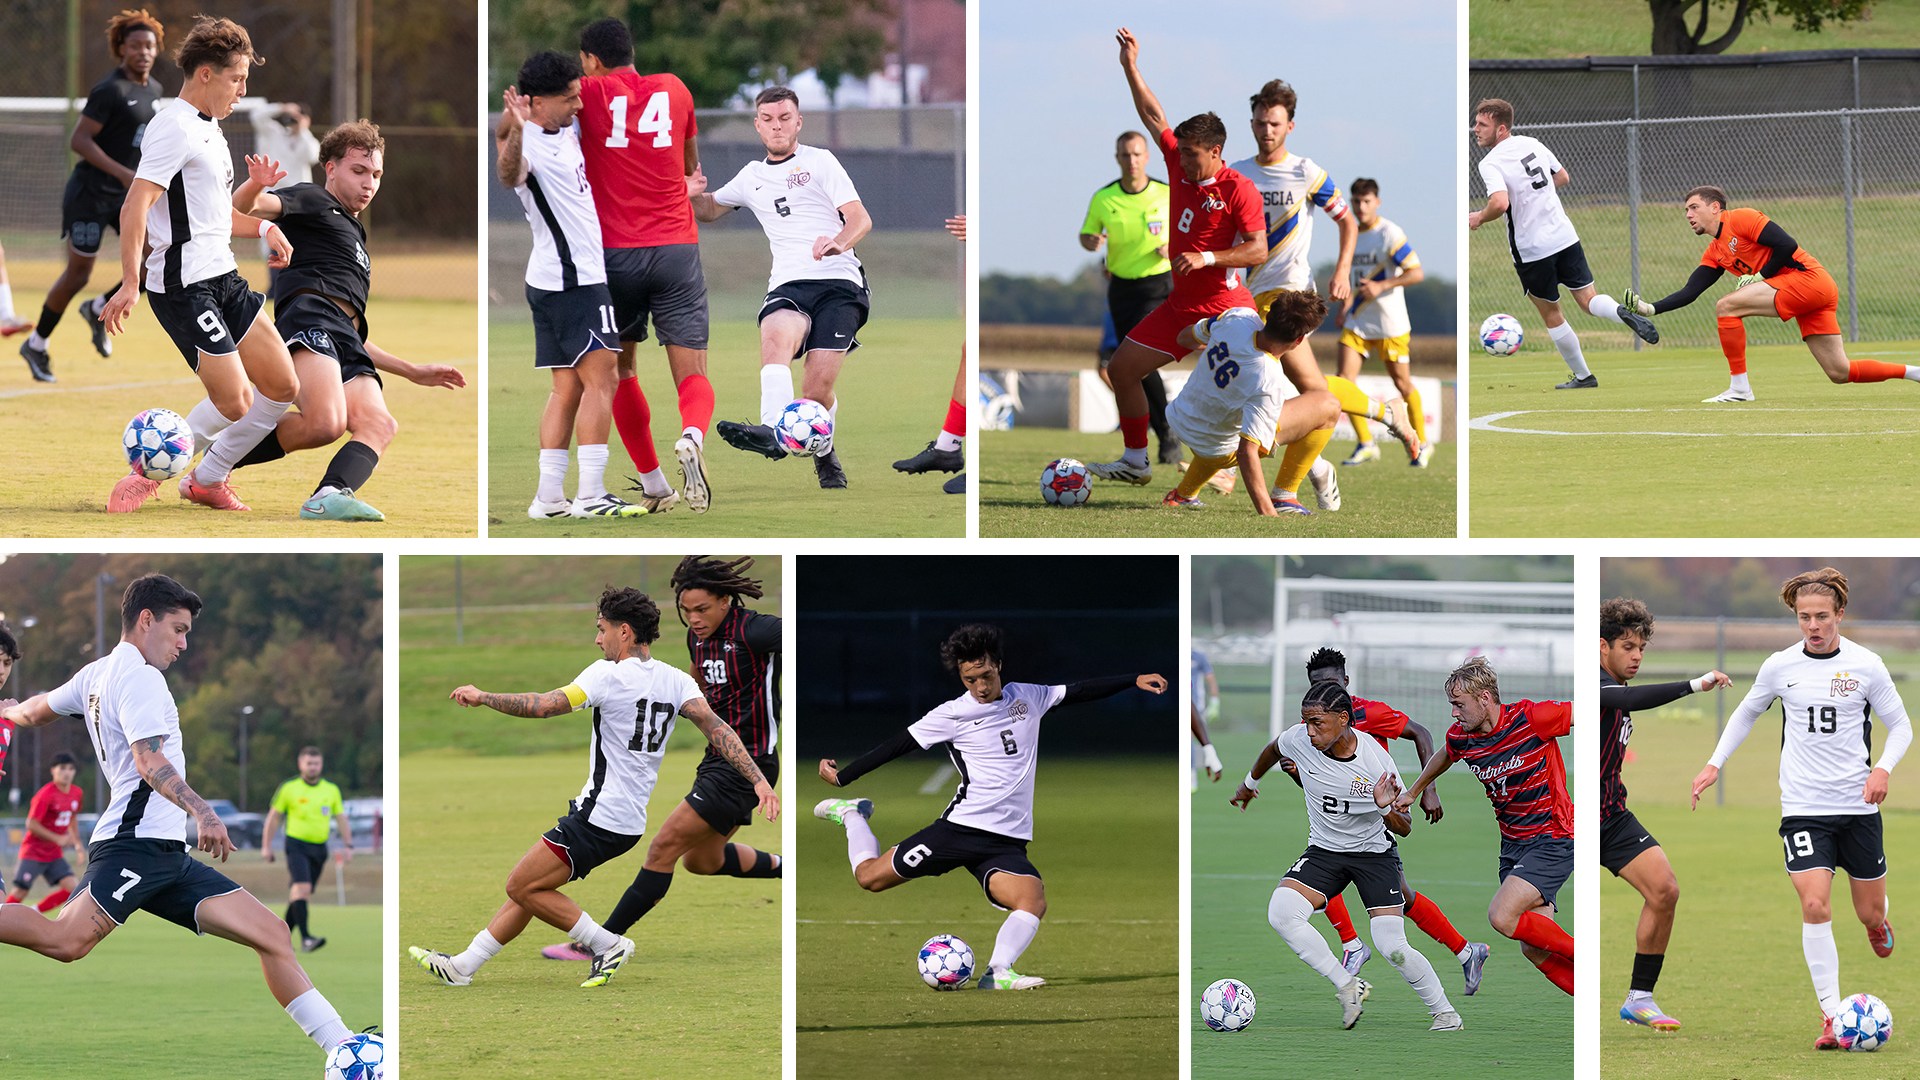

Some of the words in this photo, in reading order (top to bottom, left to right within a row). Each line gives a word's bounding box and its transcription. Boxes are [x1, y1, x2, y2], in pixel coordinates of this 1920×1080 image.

[605, 91, 673, 148] 14
[786, 171, 811, 190] RIO
[1520, 152, 1549, 190] 5
[1260, 190, 1294, 206] SCIA
[1177, 207, 1195, 234] 8
[197, 310, 227, 343] 9
[1207, 341, 1240, 390] 26
[702, 659, 738, 684] 30
[1830, 678, 1860, 697] RIO
[628, 698, 675, 753] 10
[1807, 706, 1837, 734] 19
[1000, 729, 1018, 755] 6
[1470, 754, 1525, 780] Patriots
[1489, 775, 1509, 797] 17
[1322, 795, 1350, 815] 21
[902, 844, 932, 868] 6
[1783, 830, 1815, 863] 19
[111, 867, 142, 902] 7
